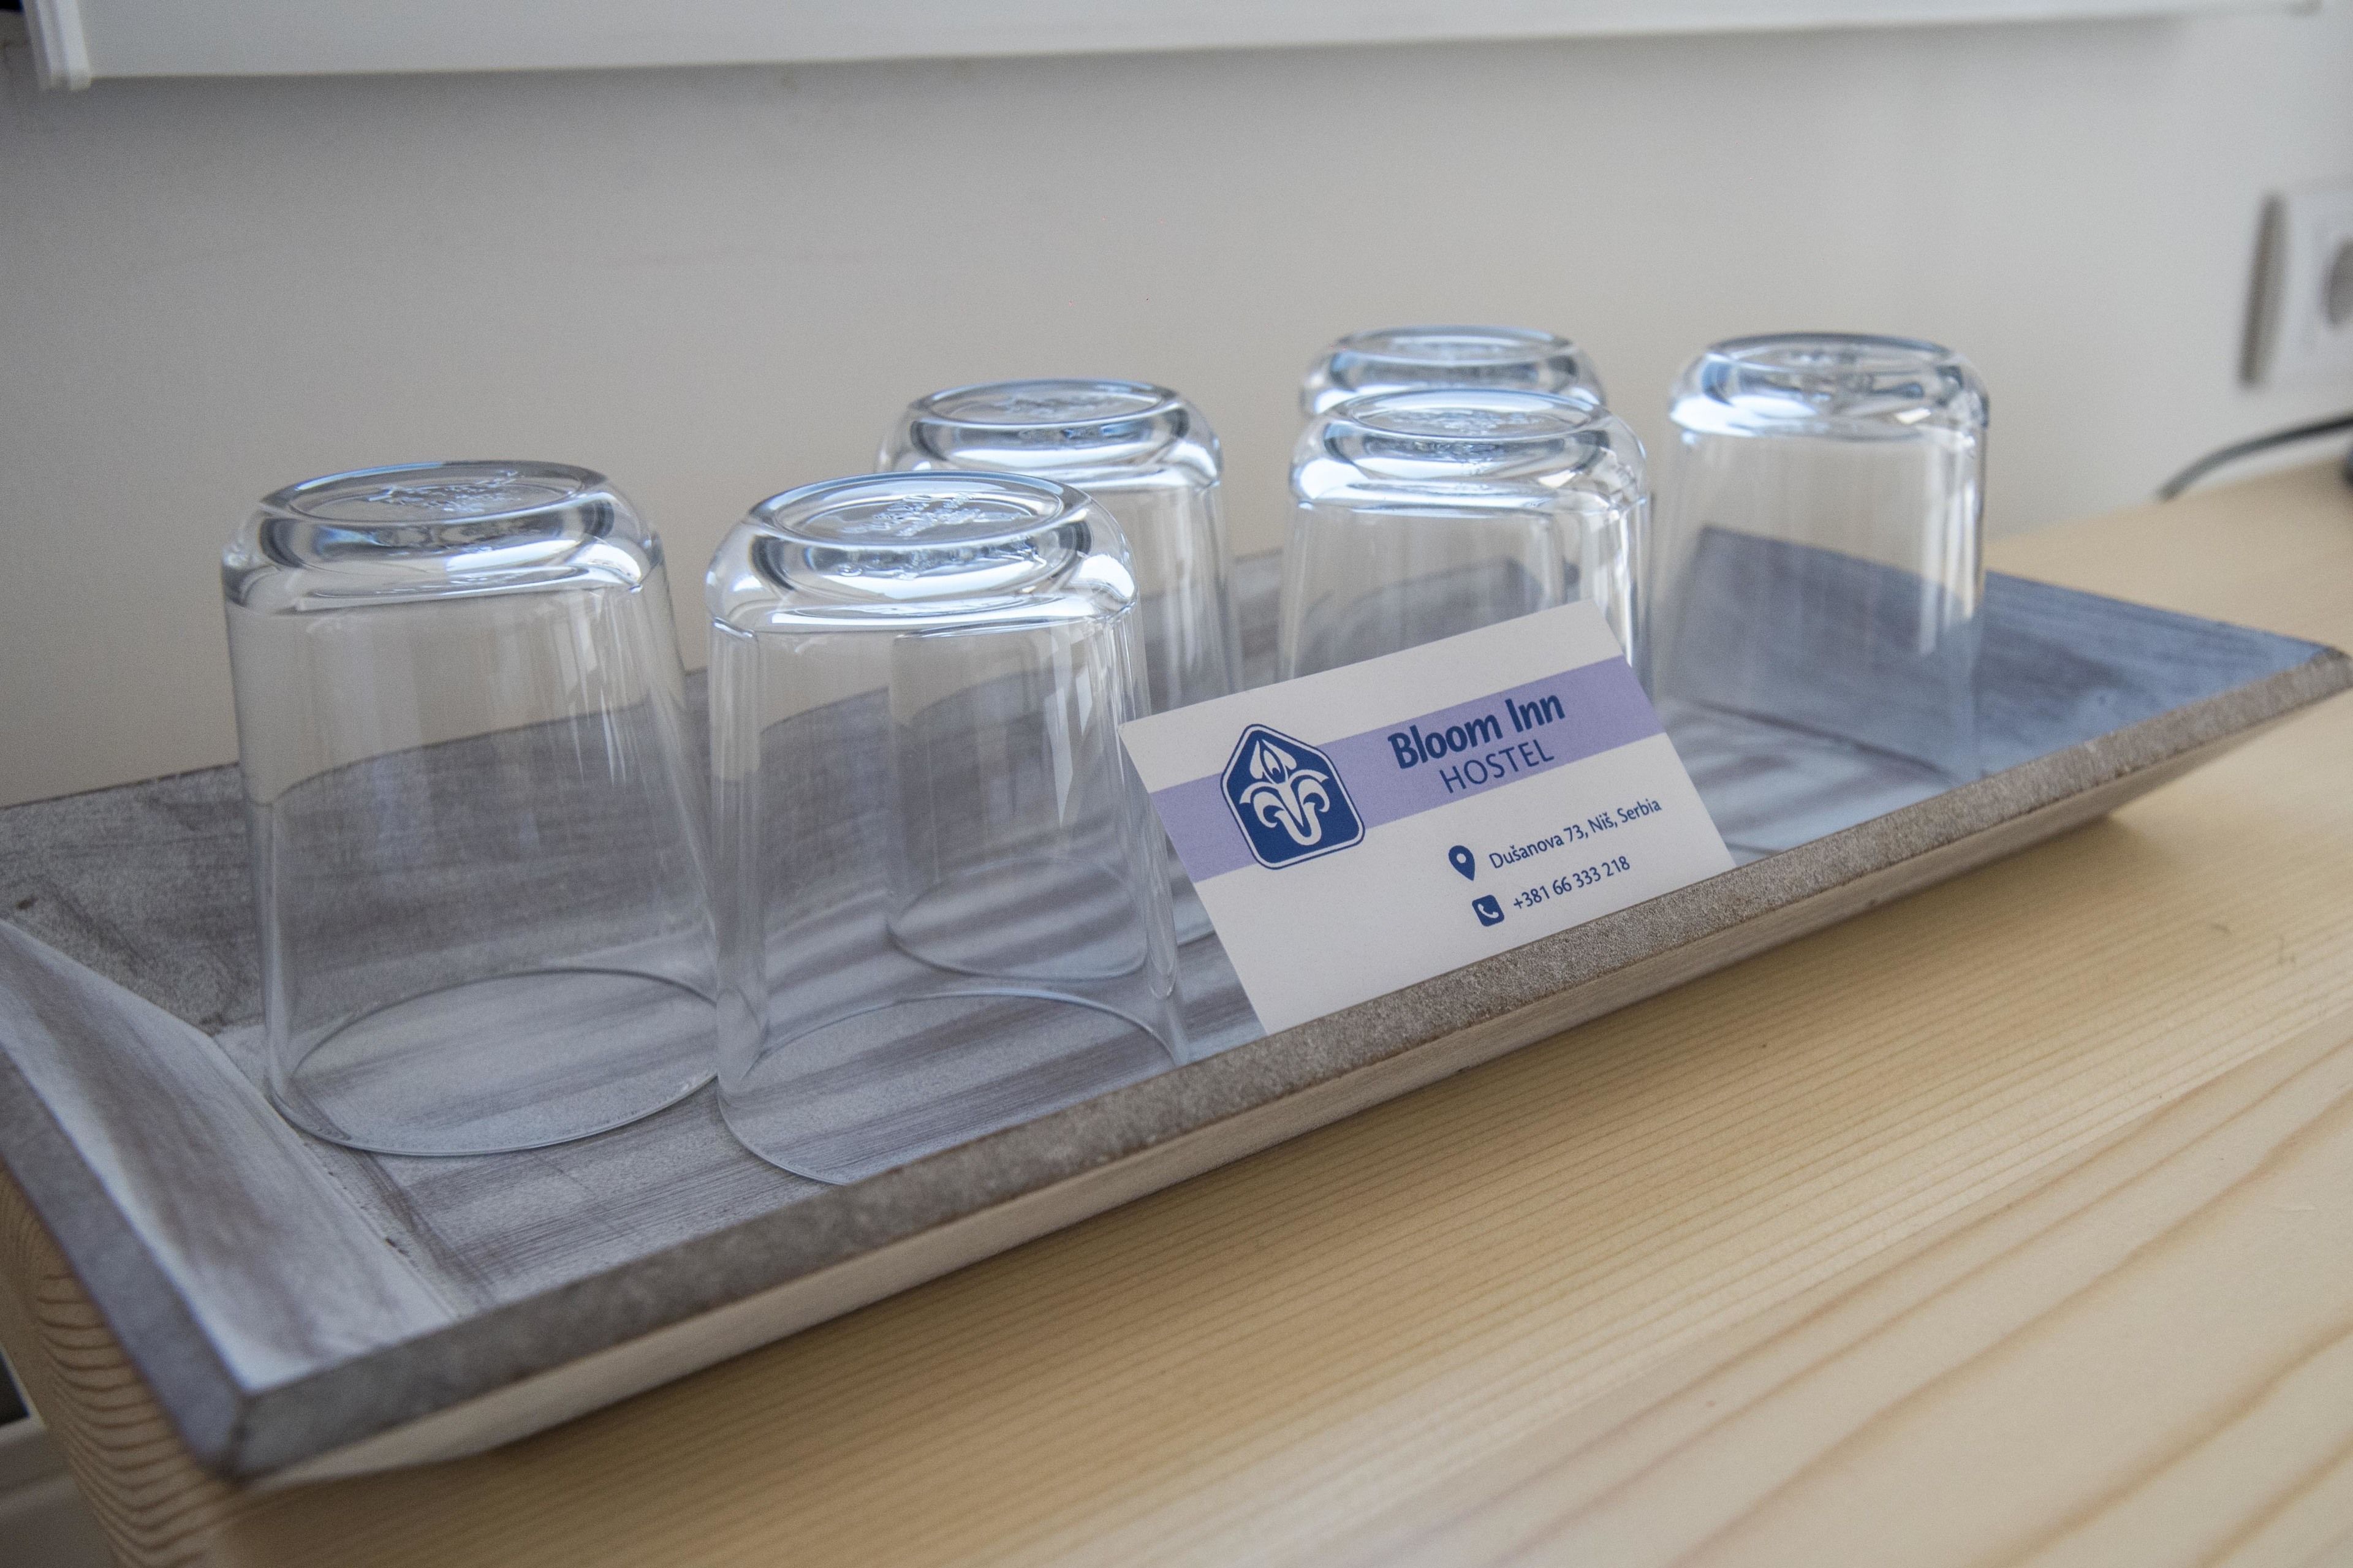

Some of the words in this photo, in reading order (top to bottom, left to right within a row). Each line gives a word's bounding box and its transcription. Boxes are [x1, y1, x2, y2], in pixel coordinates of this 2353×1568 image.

[1387, 724, 1504, 770] Bloom
[1504, 695, 1566, 733] Inn
[1439, 739, 1555, 794] HOSTEL
[1488, 835, 1565, 869] Dušanova
[1563, 824, 1590, 843] 73,
[1587, 811, 1618, 834] Niš,
[1616, 798, 1662, 824] Serbia
[1513, 885, 1550, 909] +381
[1552, 876, 1572, 896] 66
[1572, 866, 1602, 888] 333
[1601, 855, 1631, 877] 218
